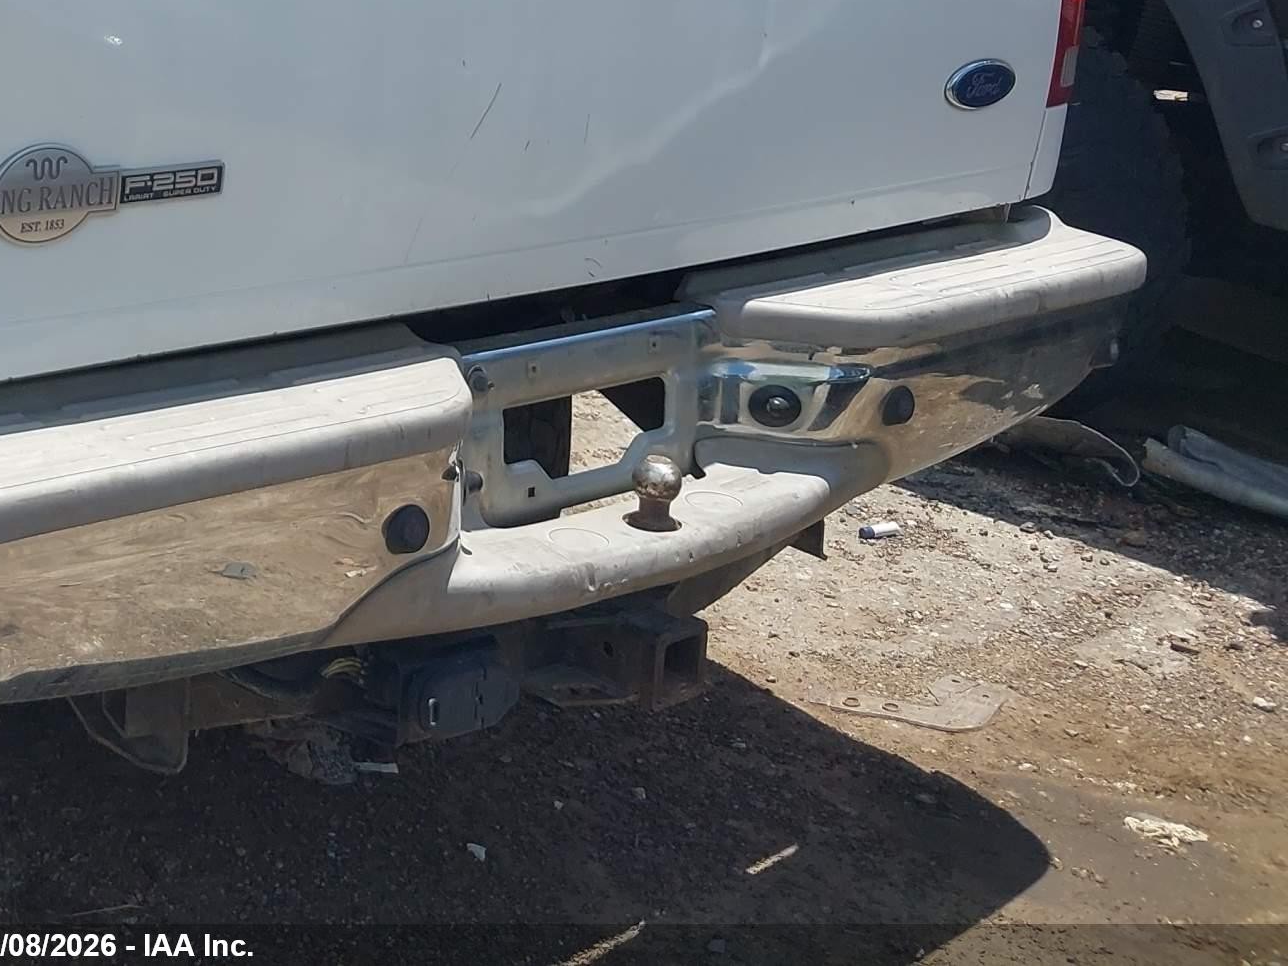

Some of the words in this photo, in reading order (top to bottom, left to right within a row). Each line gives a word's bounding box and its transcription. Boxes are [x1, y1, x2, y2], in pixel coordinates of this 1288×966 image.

[39, 176, 114, 210] RANCH
[193, 185, 217, 194] DUTY
[20, 221, 42, 234] EST.
[45, 219, 65, 231] 1853
